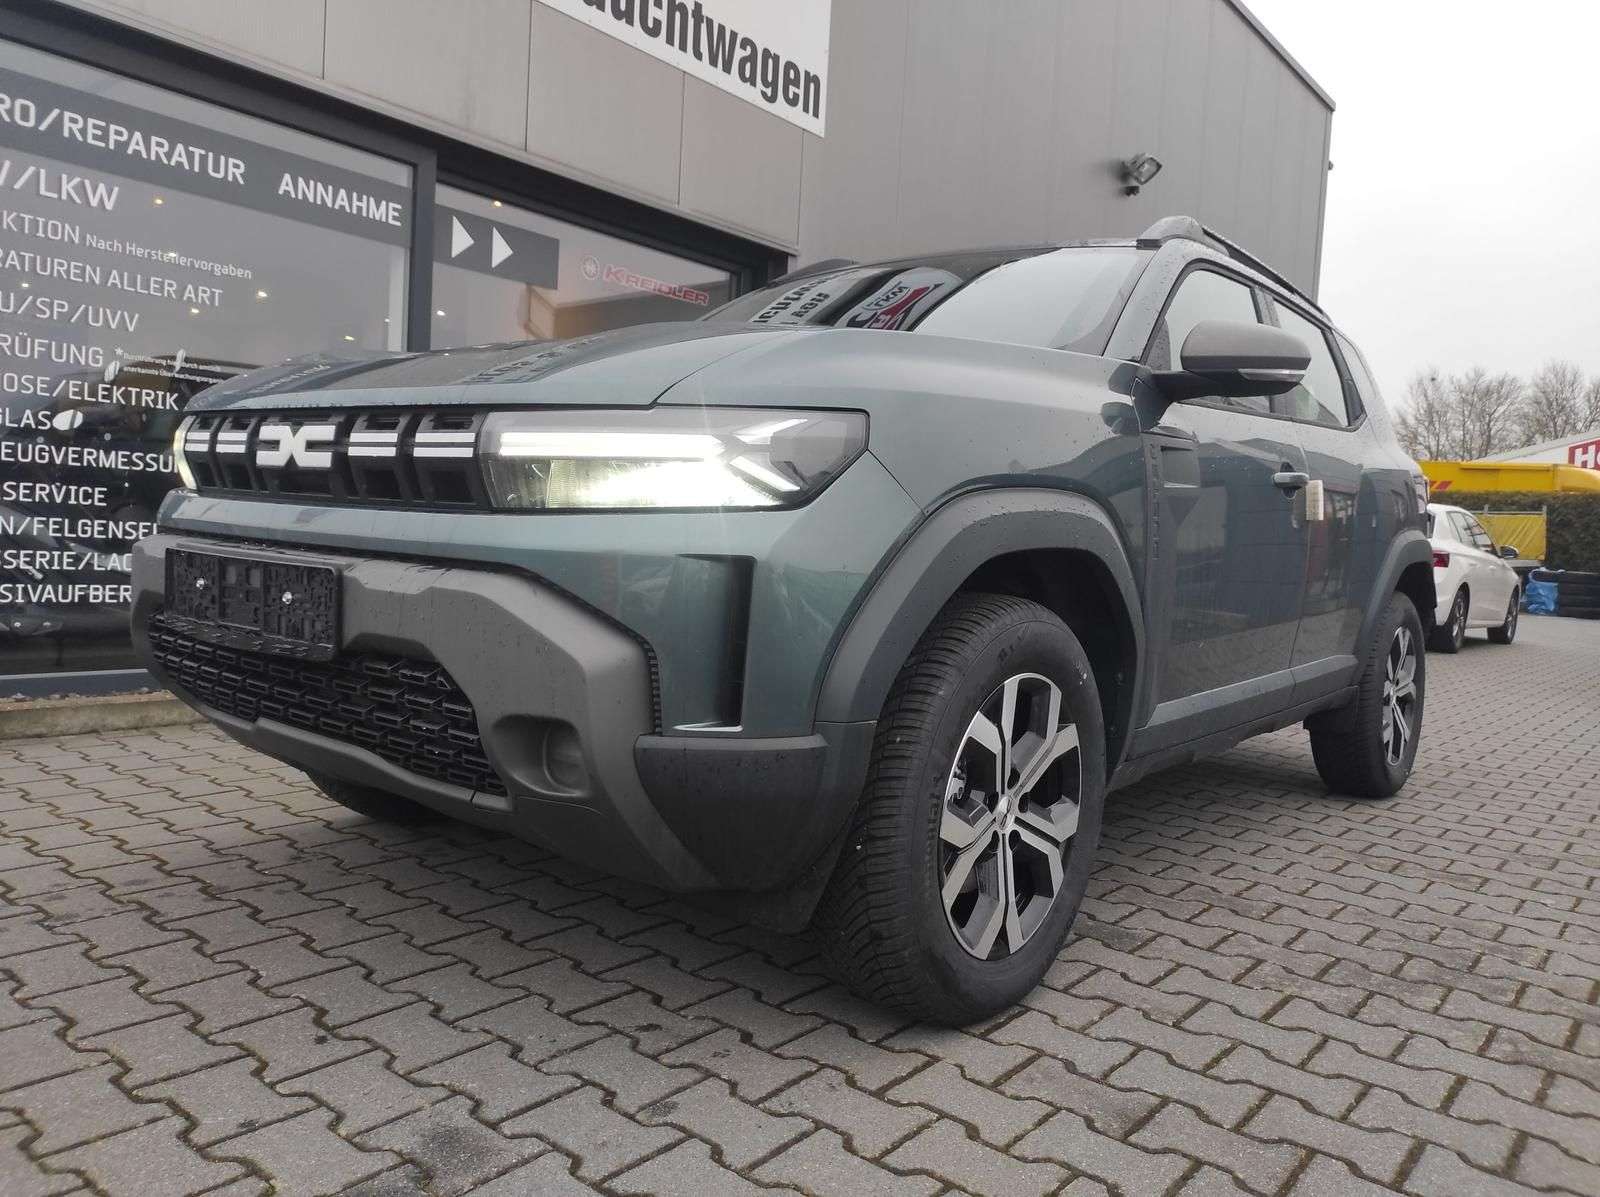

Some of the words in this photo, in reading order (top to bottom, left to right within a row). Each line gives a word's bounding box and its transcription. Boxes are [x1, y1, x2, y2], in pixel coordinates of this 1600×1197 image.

[278, 172, 402, 227] ANNAHME
[3, 210, 80, 244] KTION
[85, 233, 122, 252] Nach
[126, 241, 252, 280] Herstellervorgaben
[107, 269, 177, 299] ALLER
[183, 284, 223, 307] ART
[603, 263, 710, 306] KREIDLER
[0, 289, 139, 332] U/SP/UVV
[0, 332, 104, 368] RÜFUNG
[3, 481, 107, 506] SERVICE
[0, 583, 132, 603] SIVAUFBER
